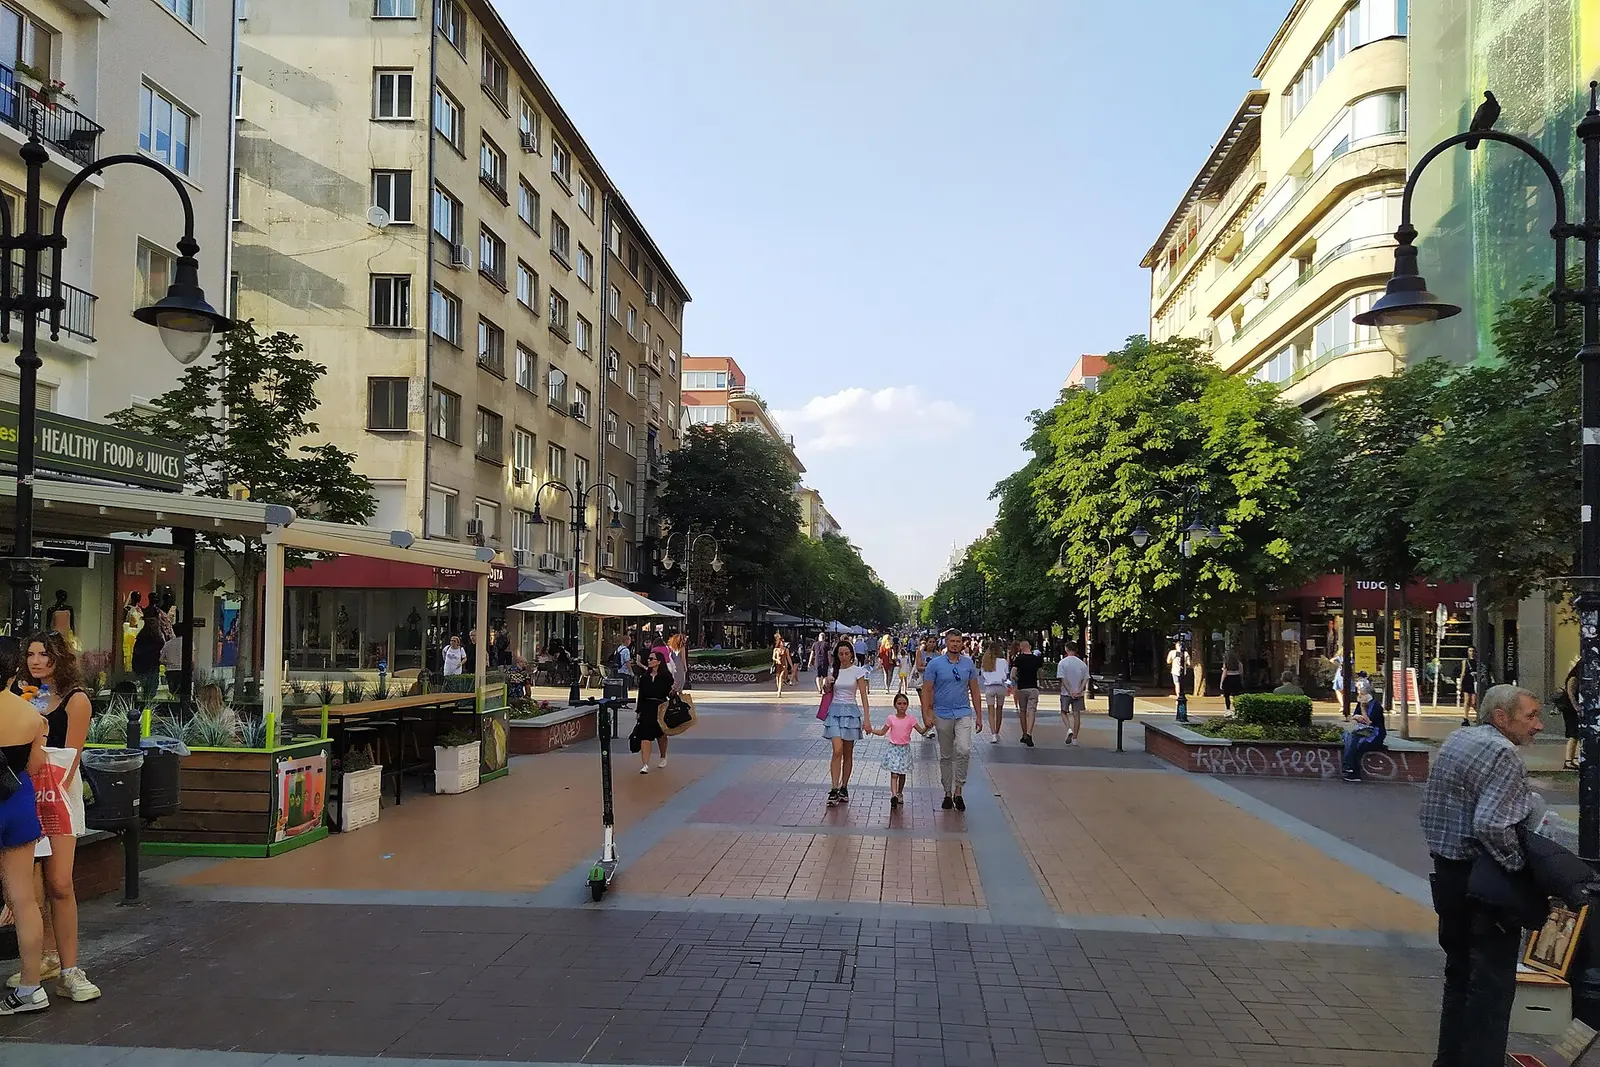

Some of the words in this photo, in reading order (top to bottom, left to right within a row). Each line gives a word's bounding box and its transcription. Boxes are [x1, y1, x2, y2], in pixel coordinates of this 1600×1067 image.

[42, 427, 99, 461] HEALTHY
[103, 441, 134, 468] FOOD
[136, 451, 144, 466] &
[144, 451, 179, 479] JUICES
